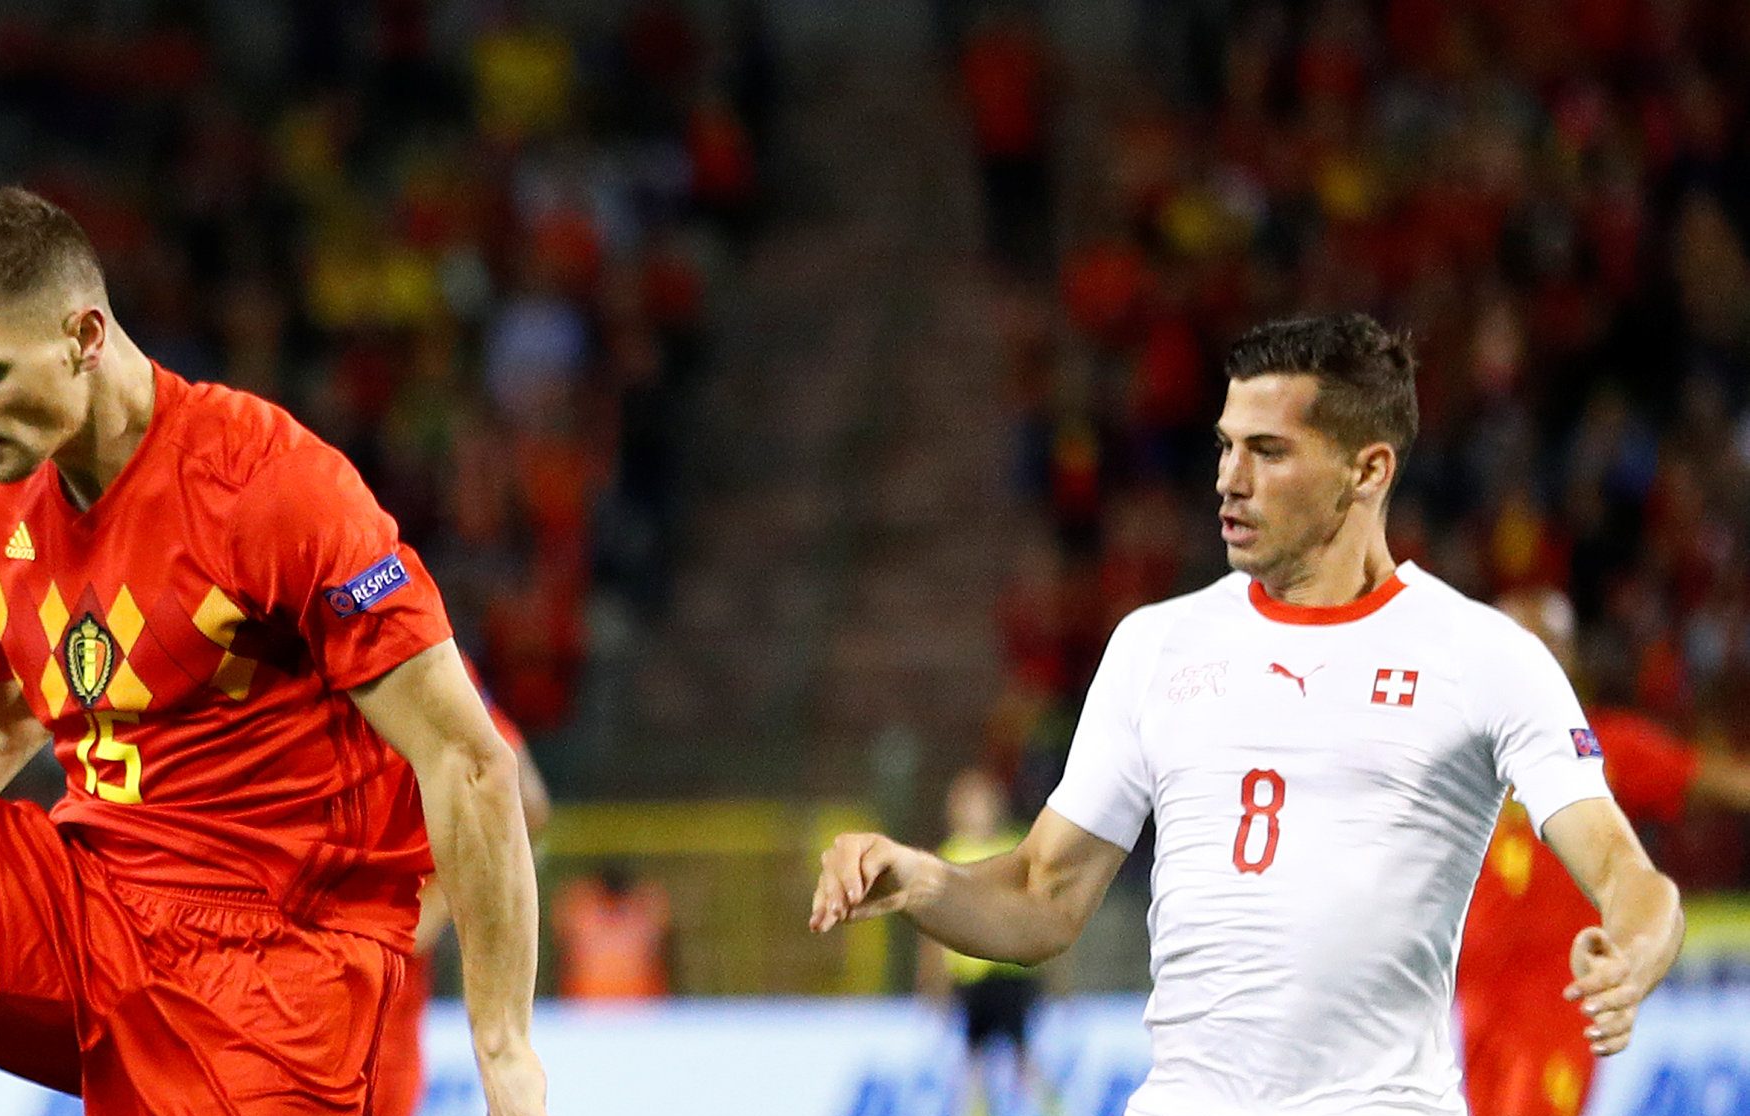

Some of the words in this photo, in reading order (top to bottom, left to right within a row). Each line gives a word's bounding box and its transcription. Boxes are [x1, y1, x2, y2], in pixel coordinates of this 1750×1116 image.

[351, 559, 405, 604] RESPECT
[76, 710, 144, 805] 15
[1232, 767, 1286, 876] 8
